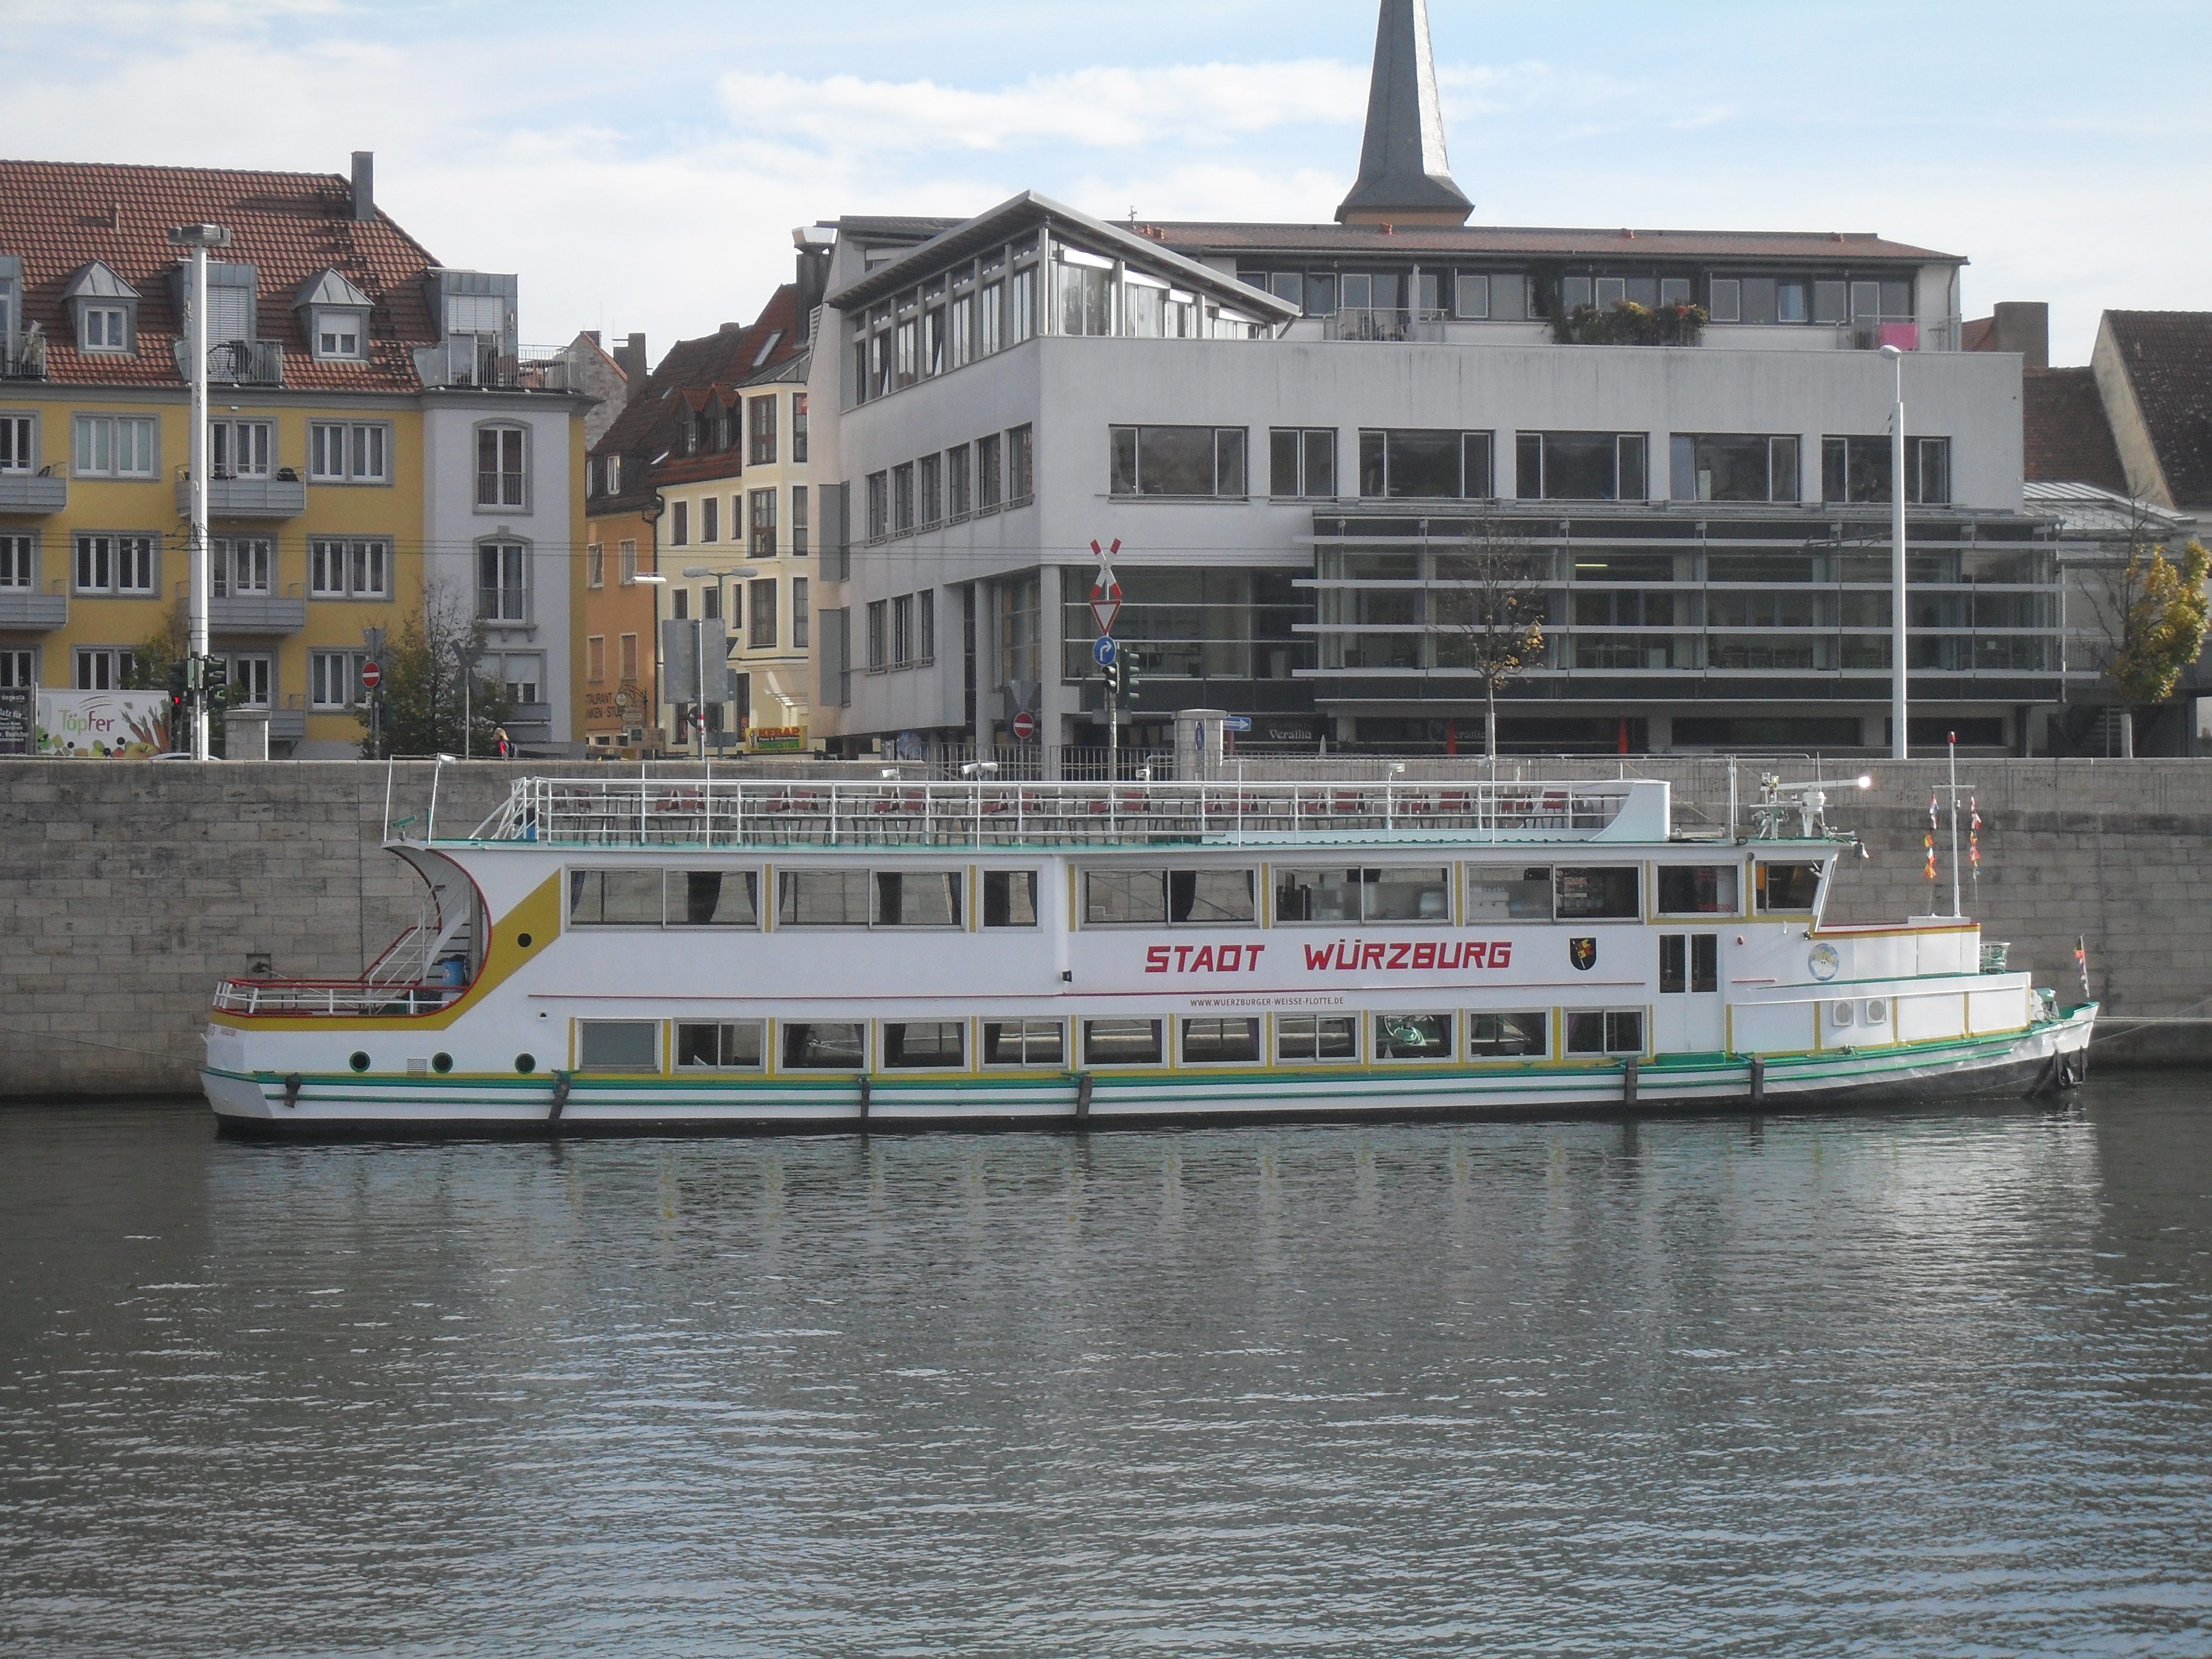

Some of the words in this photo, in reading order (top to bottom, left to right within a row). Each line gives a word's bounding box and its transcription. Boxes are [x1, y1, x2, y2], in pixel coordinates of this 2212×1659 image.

[59, 709, 115, 736] Töpfer
[759, 727, 800, 737] KEBAP
[1269, 729, 1312, 739] Versilia
[1145, 945, 1265, 973] STADT
[1304, 939, 1512, 970] WÜRZBURG
[1190, 997, 1344, 1007] WWW.WUERZBURGER-WEISSE-FLOTTE.DE
